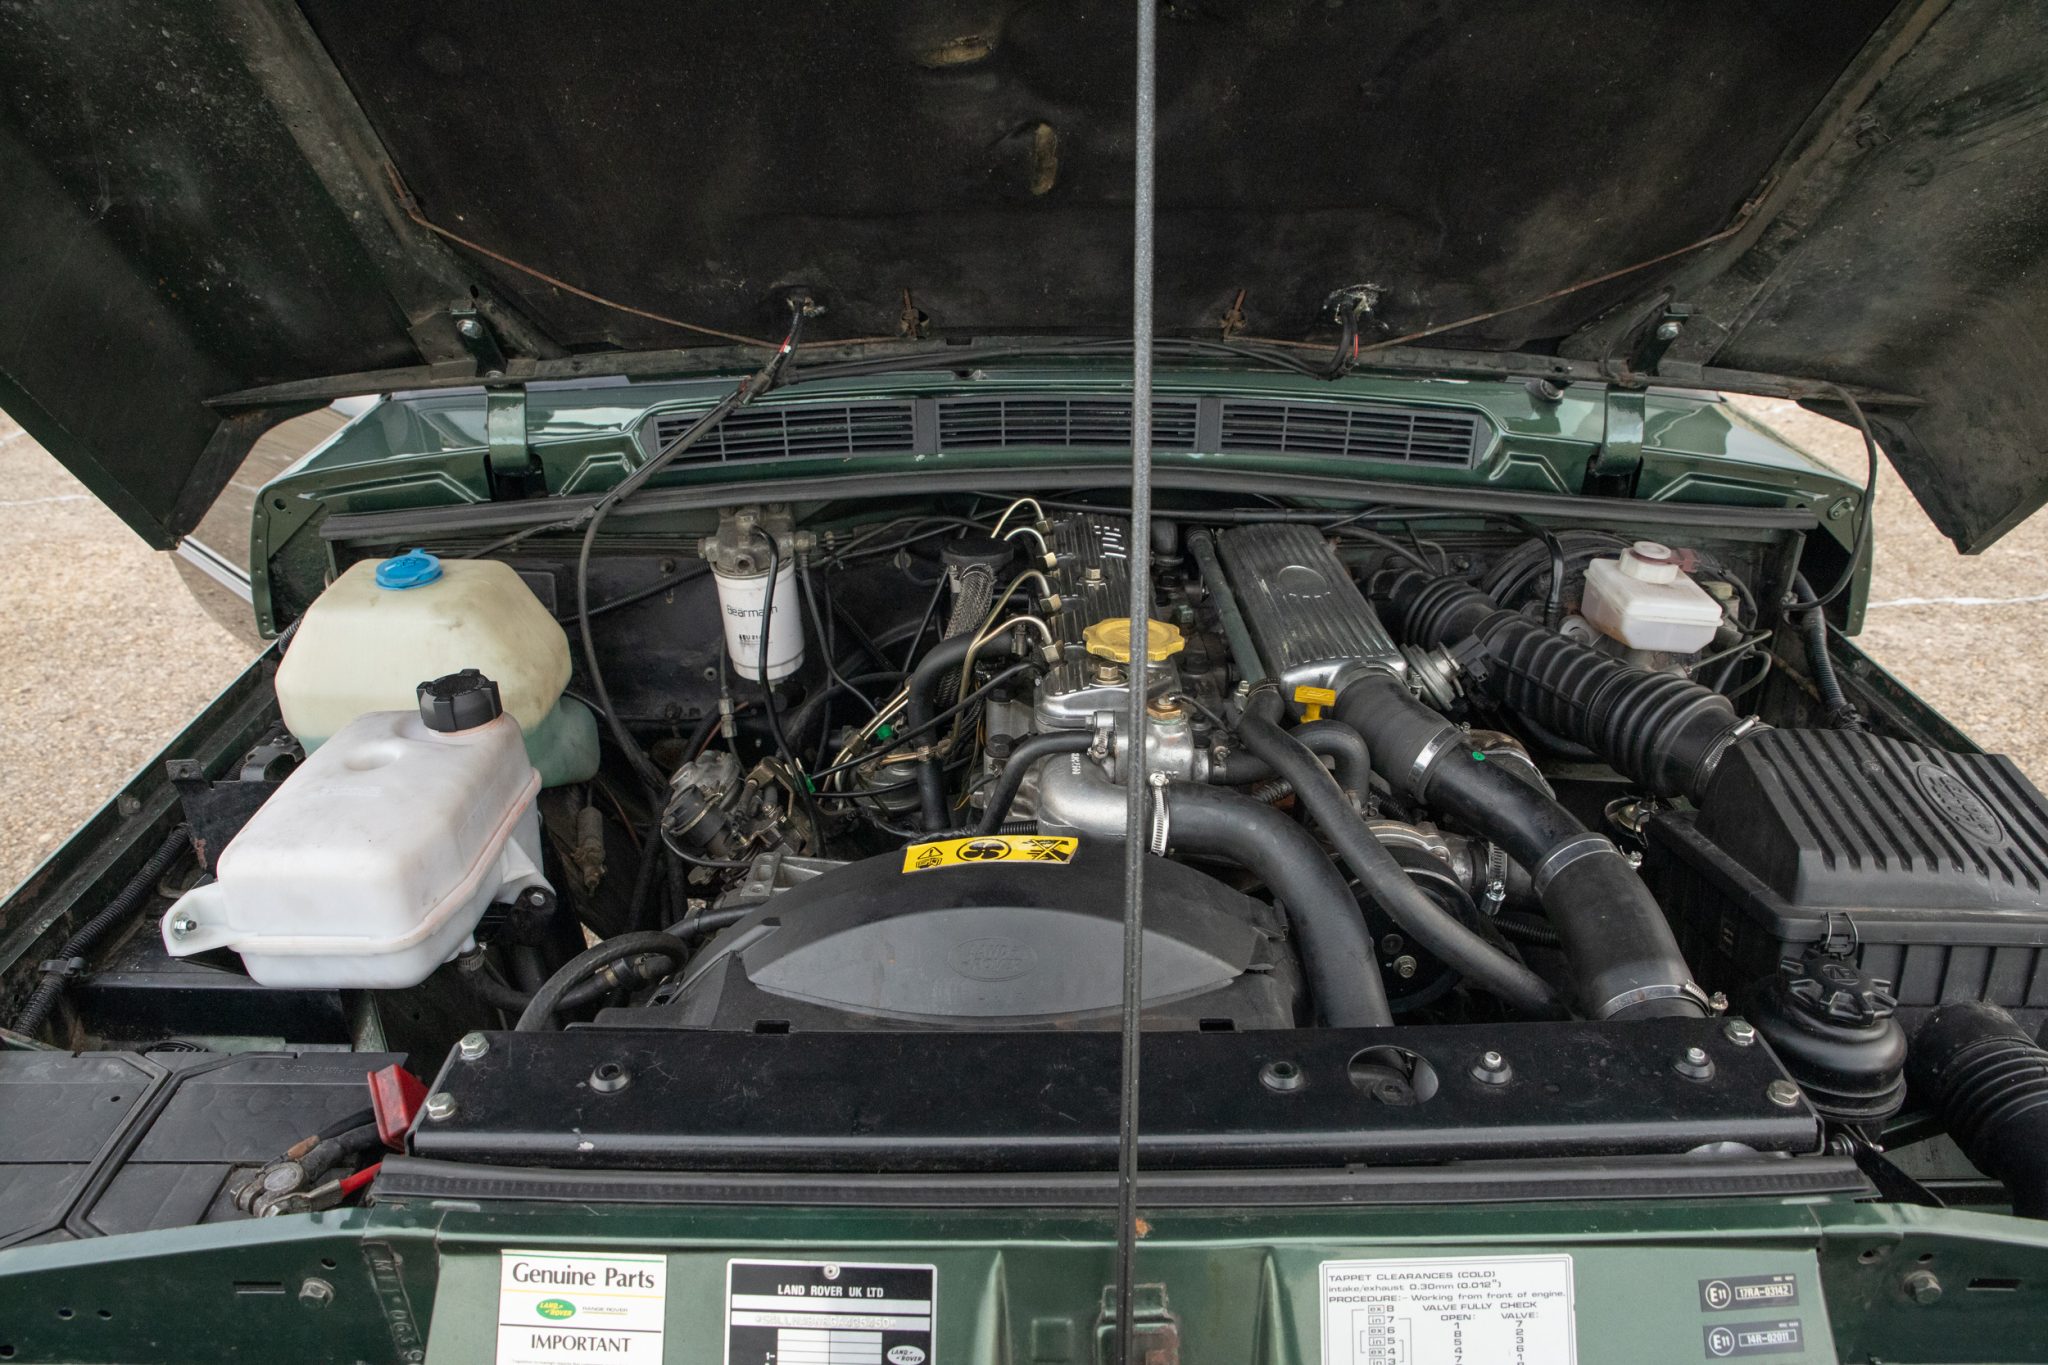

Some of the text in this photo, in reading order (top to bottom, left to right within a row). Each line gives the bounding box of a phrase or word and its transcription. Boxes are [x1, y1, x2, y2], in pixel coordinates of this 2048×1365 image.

[512, 1262, 655, 1289] Genuine Parts
[1329, 1271, 1496, 1282] TAPPET CLEARANCES (COLD)
[777, 1284, 884, 1298] LAND ROVER UK LTD
[1329, 1285, 1404, 1293] intake/exhaust
[1411, 1294, 1453, 1302] Working
[1531, 1290, 1565, 1299] engine.
[1422, 1303, 1457, 1311] VALVE
[549, 1309, 573, 1317] ROVER
[1501, 1312, 1539, 1320] VALVE:
[1387, 1326, 1395, 1334] 6
[1454, 1330, 1462, 1338] 8
[1516, 1328, 1524, 1336] 2
[531, 1334, 631, 1352] IMPORTANT
[1388, 1337, 1396, 1345] 5
